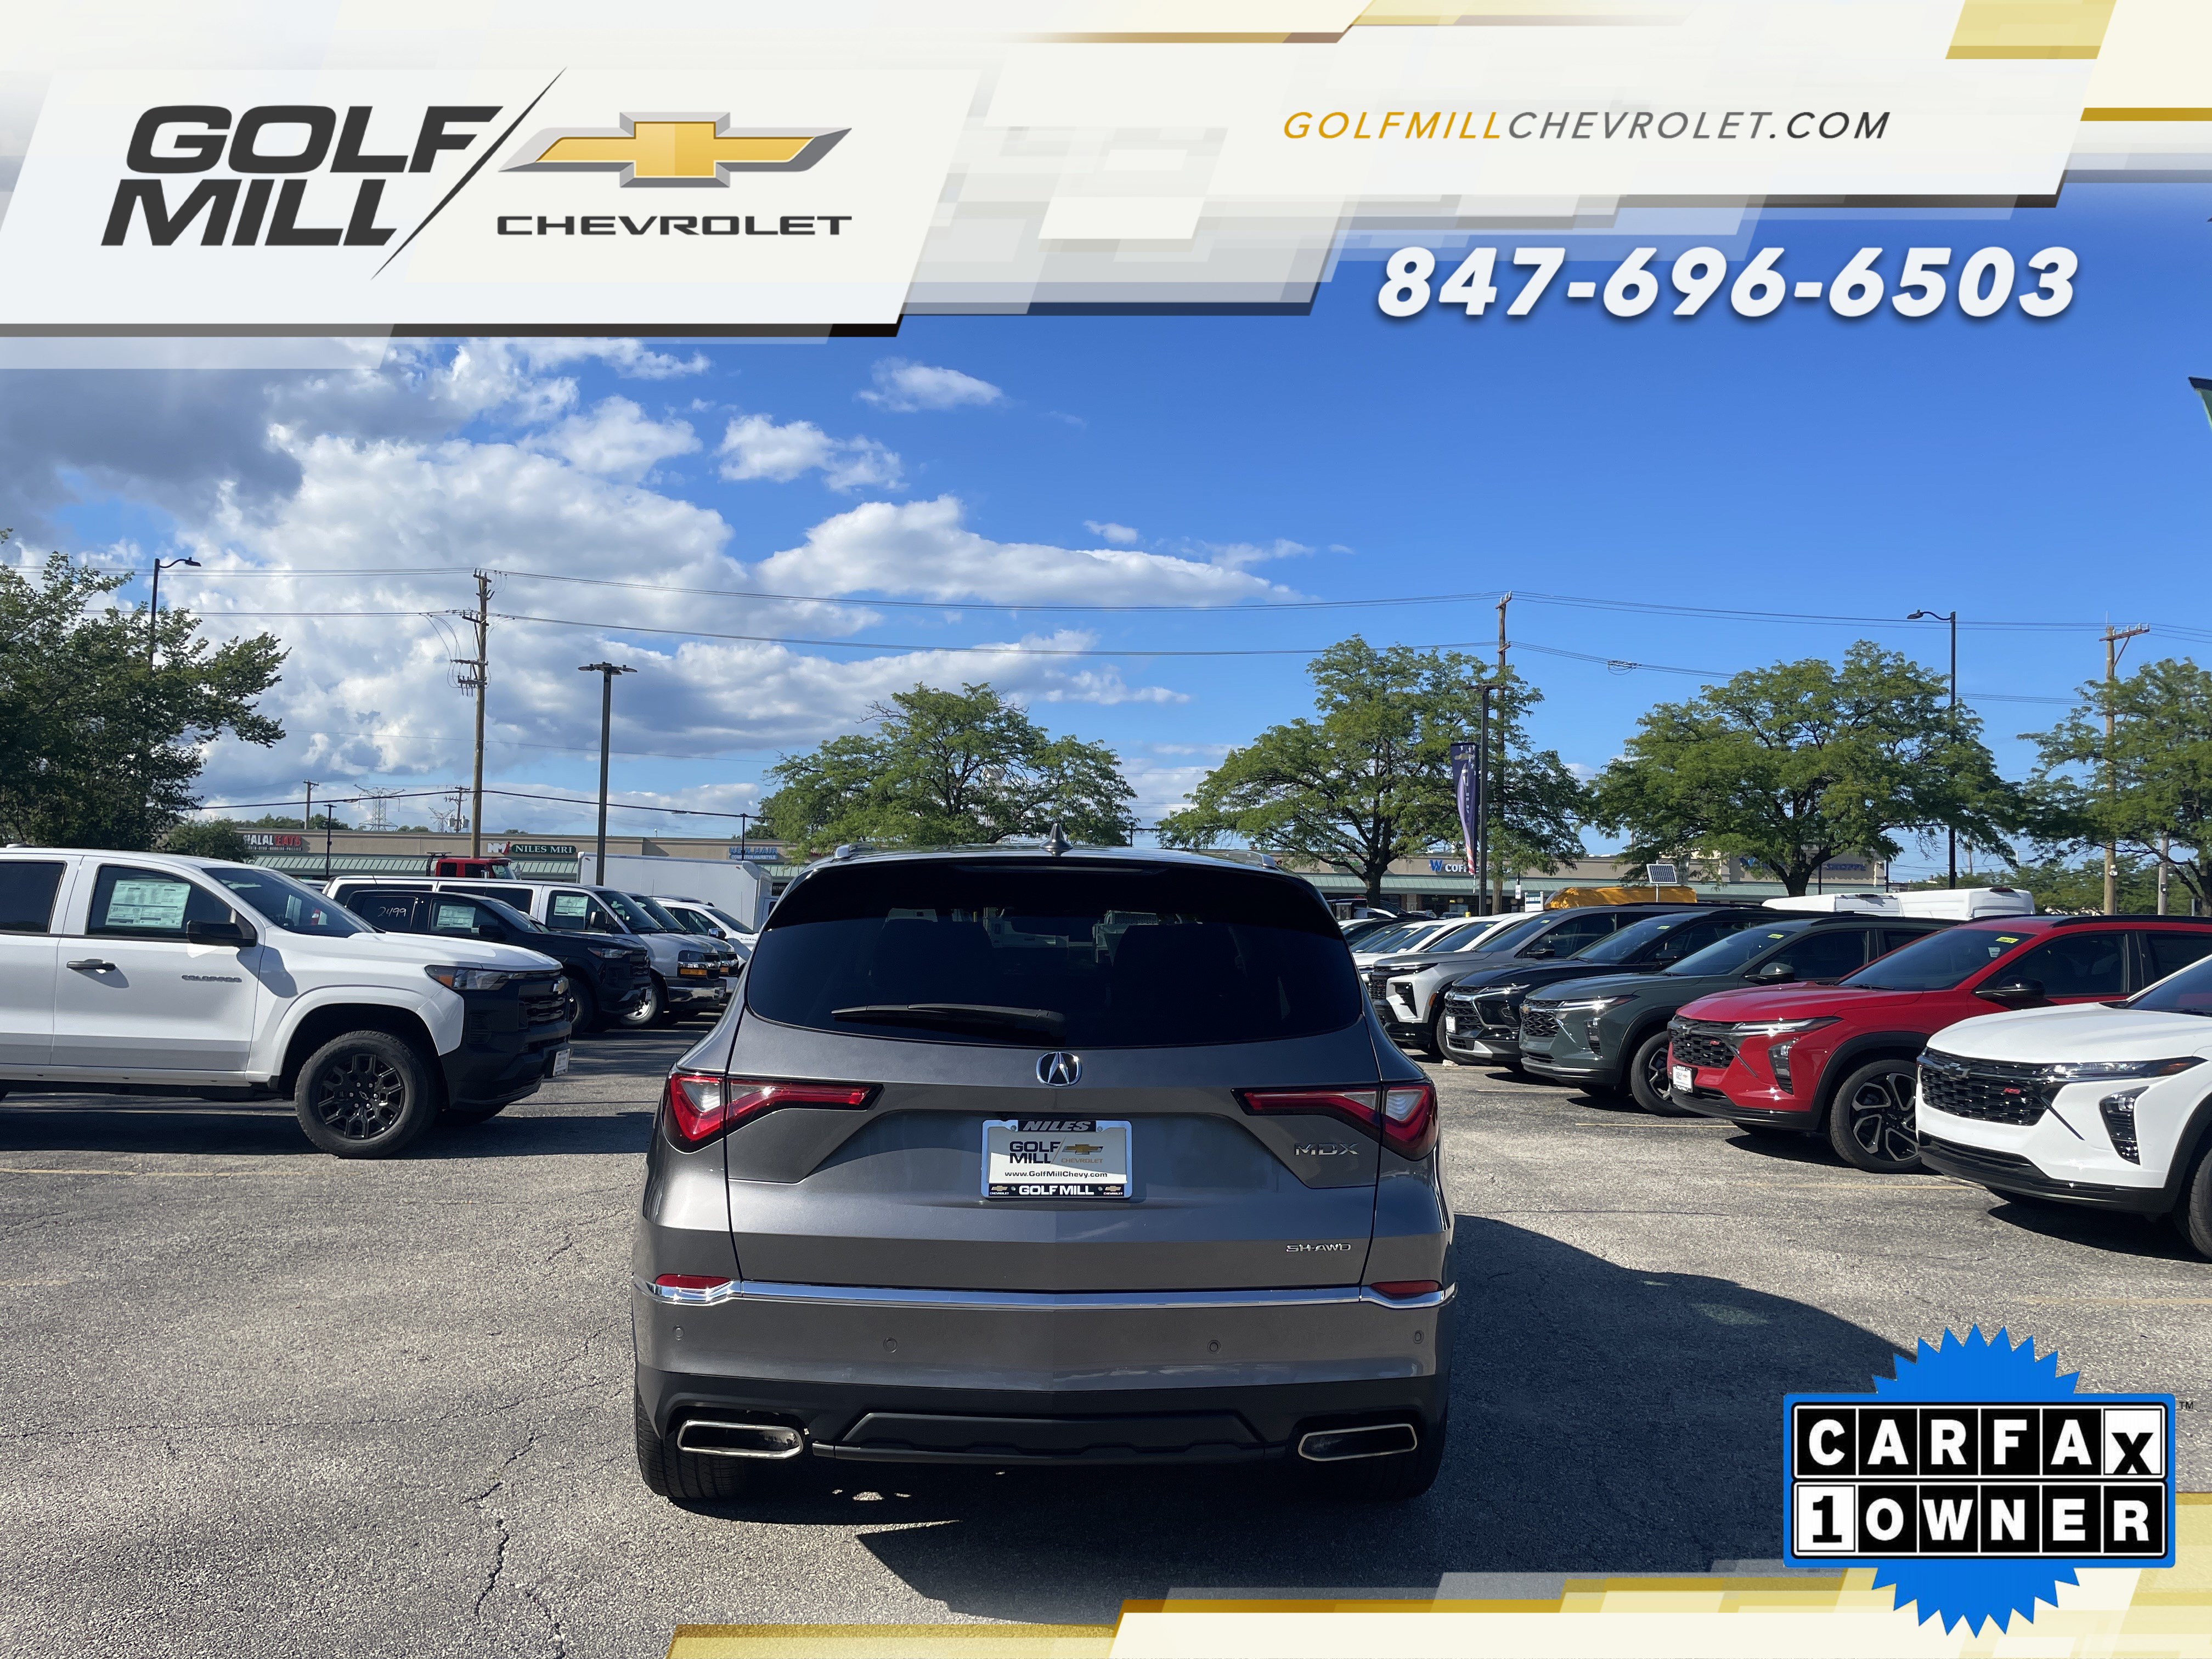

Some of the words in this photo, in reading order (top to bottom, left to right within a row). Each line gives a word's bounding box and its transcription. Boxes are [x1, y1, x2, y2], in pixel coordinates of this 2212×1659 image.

[243, 834, 274, 845] HALAL
[275, 836, 301, 846] EATS
[1023, 1120, 1091, 1132] NILES
[1009, 1141, 1061, 1153] GOLF
[1295, 1143, 1360, 1156] MDX
[1009, 1153, 1051, 1164] MILL
[1005, 1170, 1108, 1178] www.GolfMillChevy.com
[1019, 1185, 1059, 1195] GOLF
[1059, 1185, 1094, 1195] MILL
[1286, 1243, 1352, 1252] SH-AWD
